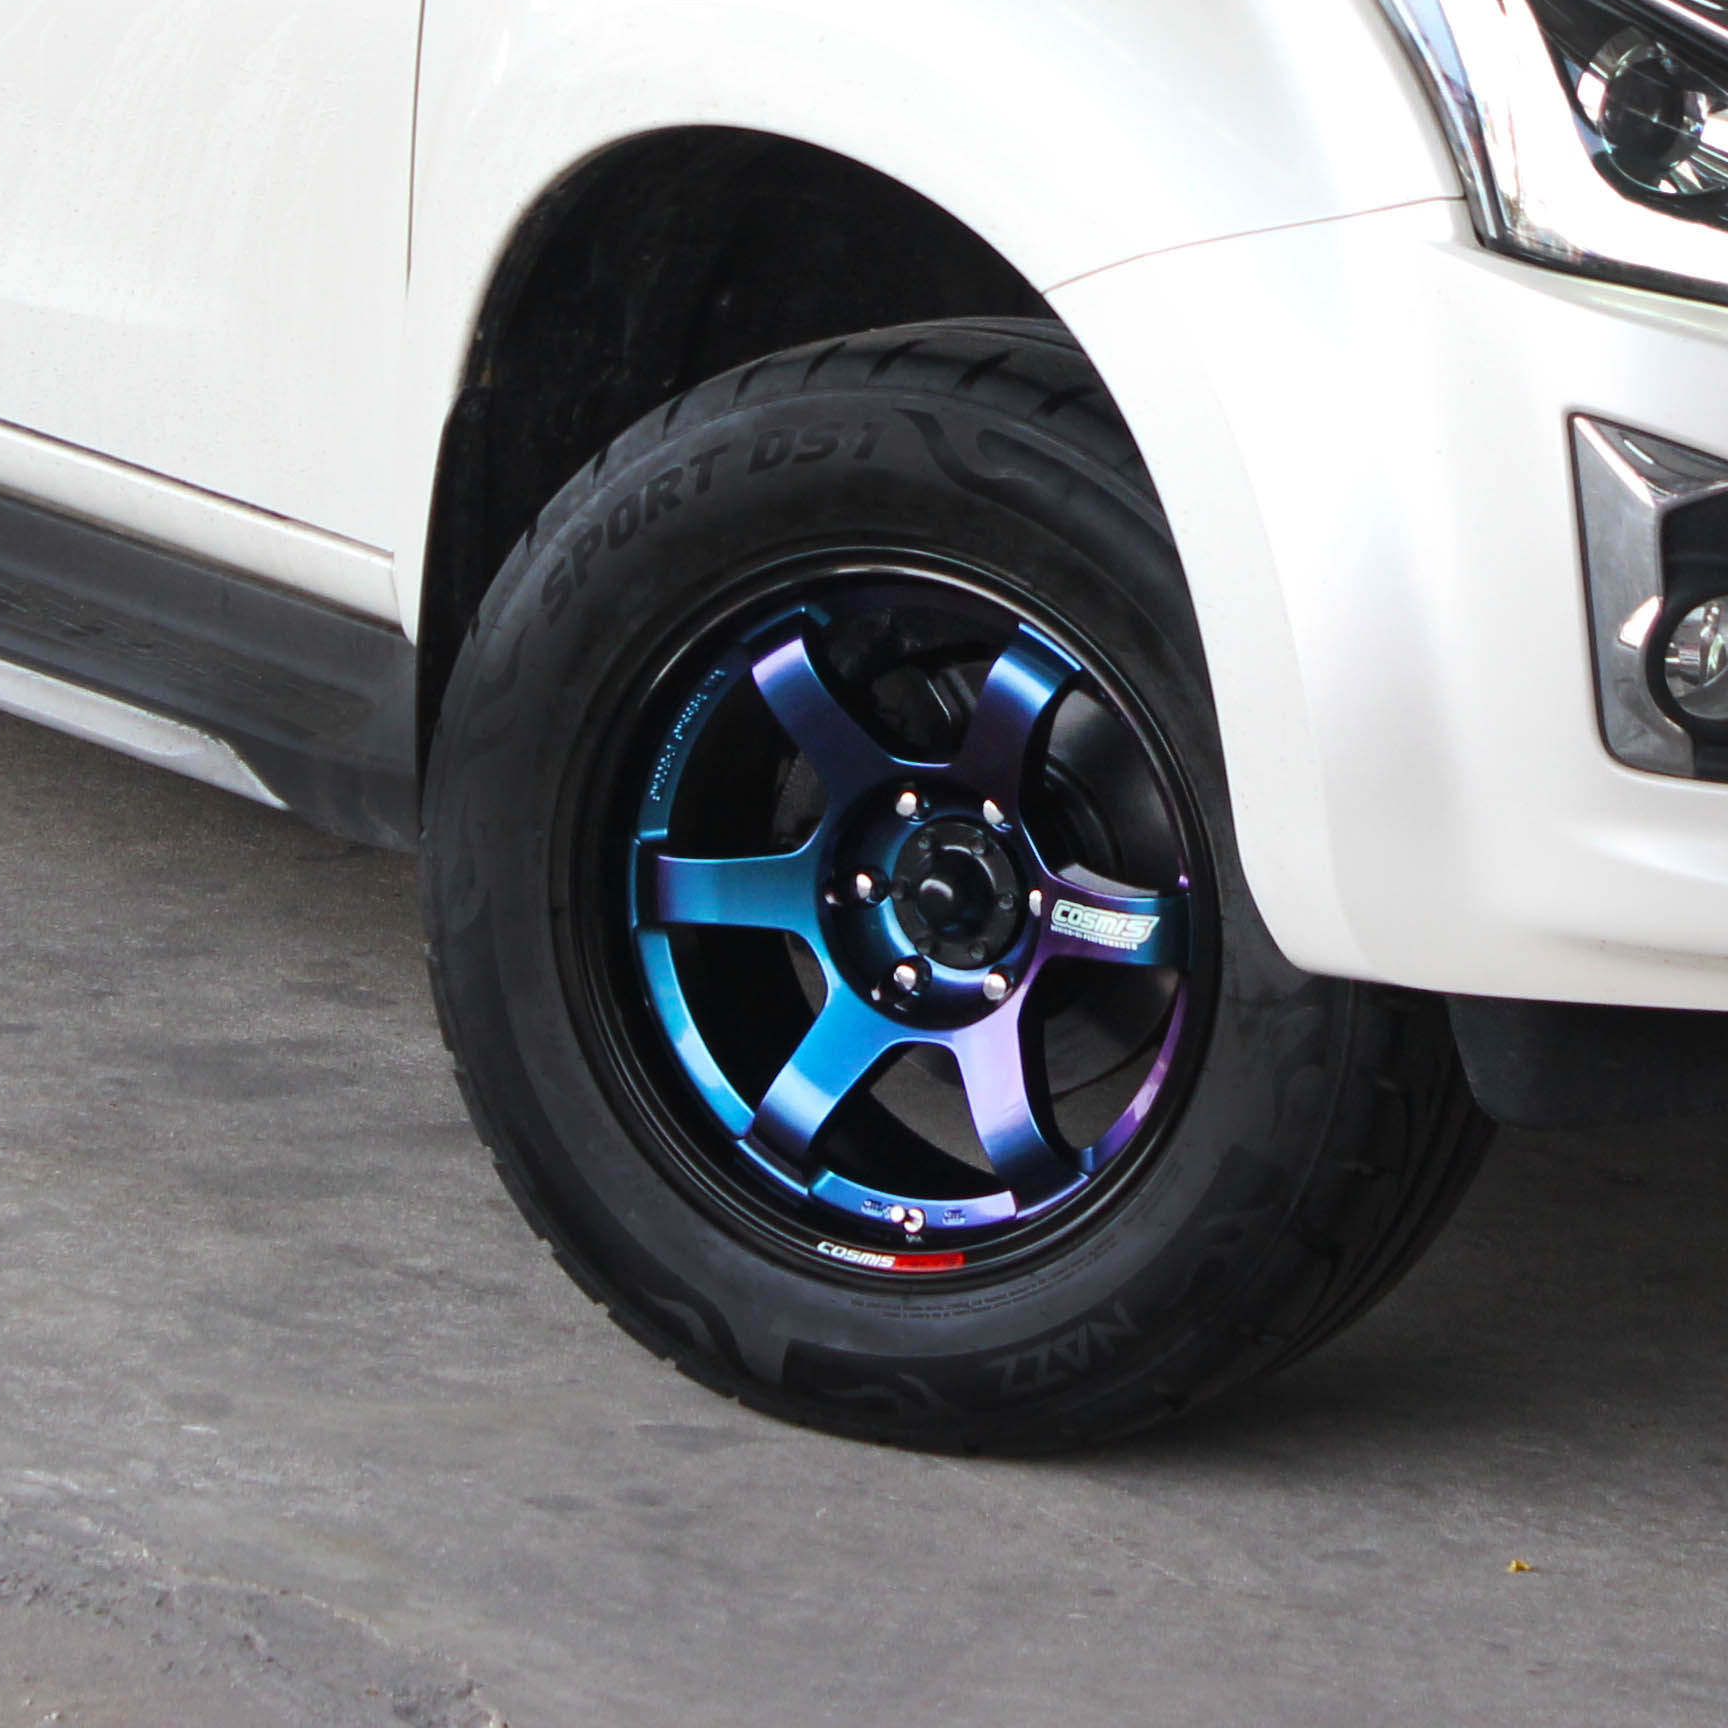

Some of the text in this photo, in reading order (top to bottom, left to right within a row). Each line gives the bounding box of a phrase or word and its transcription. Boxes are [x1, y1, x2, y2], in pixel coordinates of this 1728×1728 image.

[540, 442, 729, 626] SPORT
[1054, 903, 1149, 941] COSMIS
[816, 1240, 897, 1269] COSMIS
